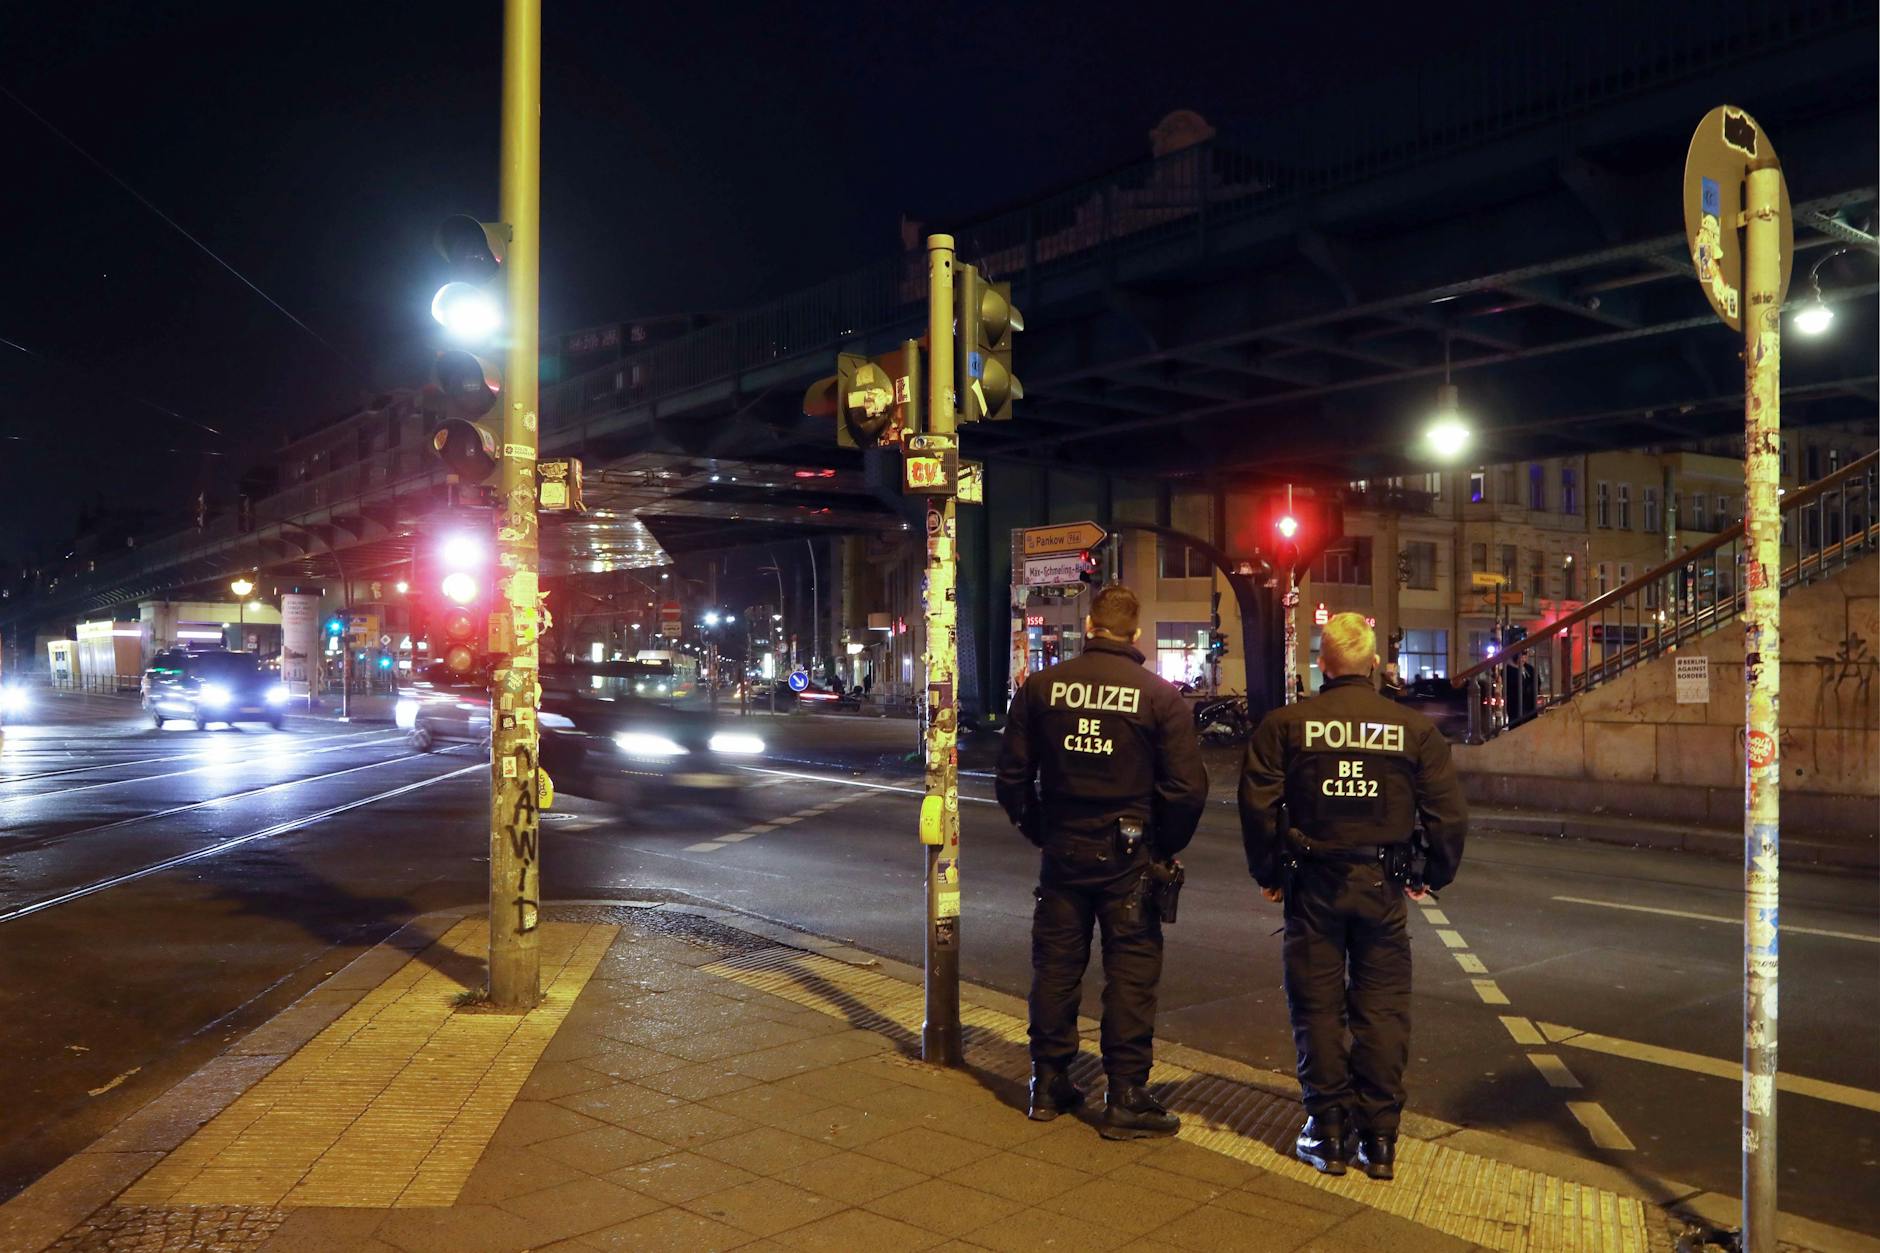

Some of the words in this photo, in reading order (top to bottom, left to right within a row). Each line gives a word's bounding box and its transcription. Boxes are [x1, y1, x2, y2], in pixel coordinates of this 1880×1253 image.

[1035, 536, 1064, 547] Pankow
[1050, 681, 1140, 713] POLIZEI
[1078, 718, 1101, 736] BE
[1305, 720, 1404, 752] POLIZEI
[1063, 734, 1113, 755] C1134
[1338, 760, 1364, 778] BE
[1321, 779, 1379, 797] C1132
